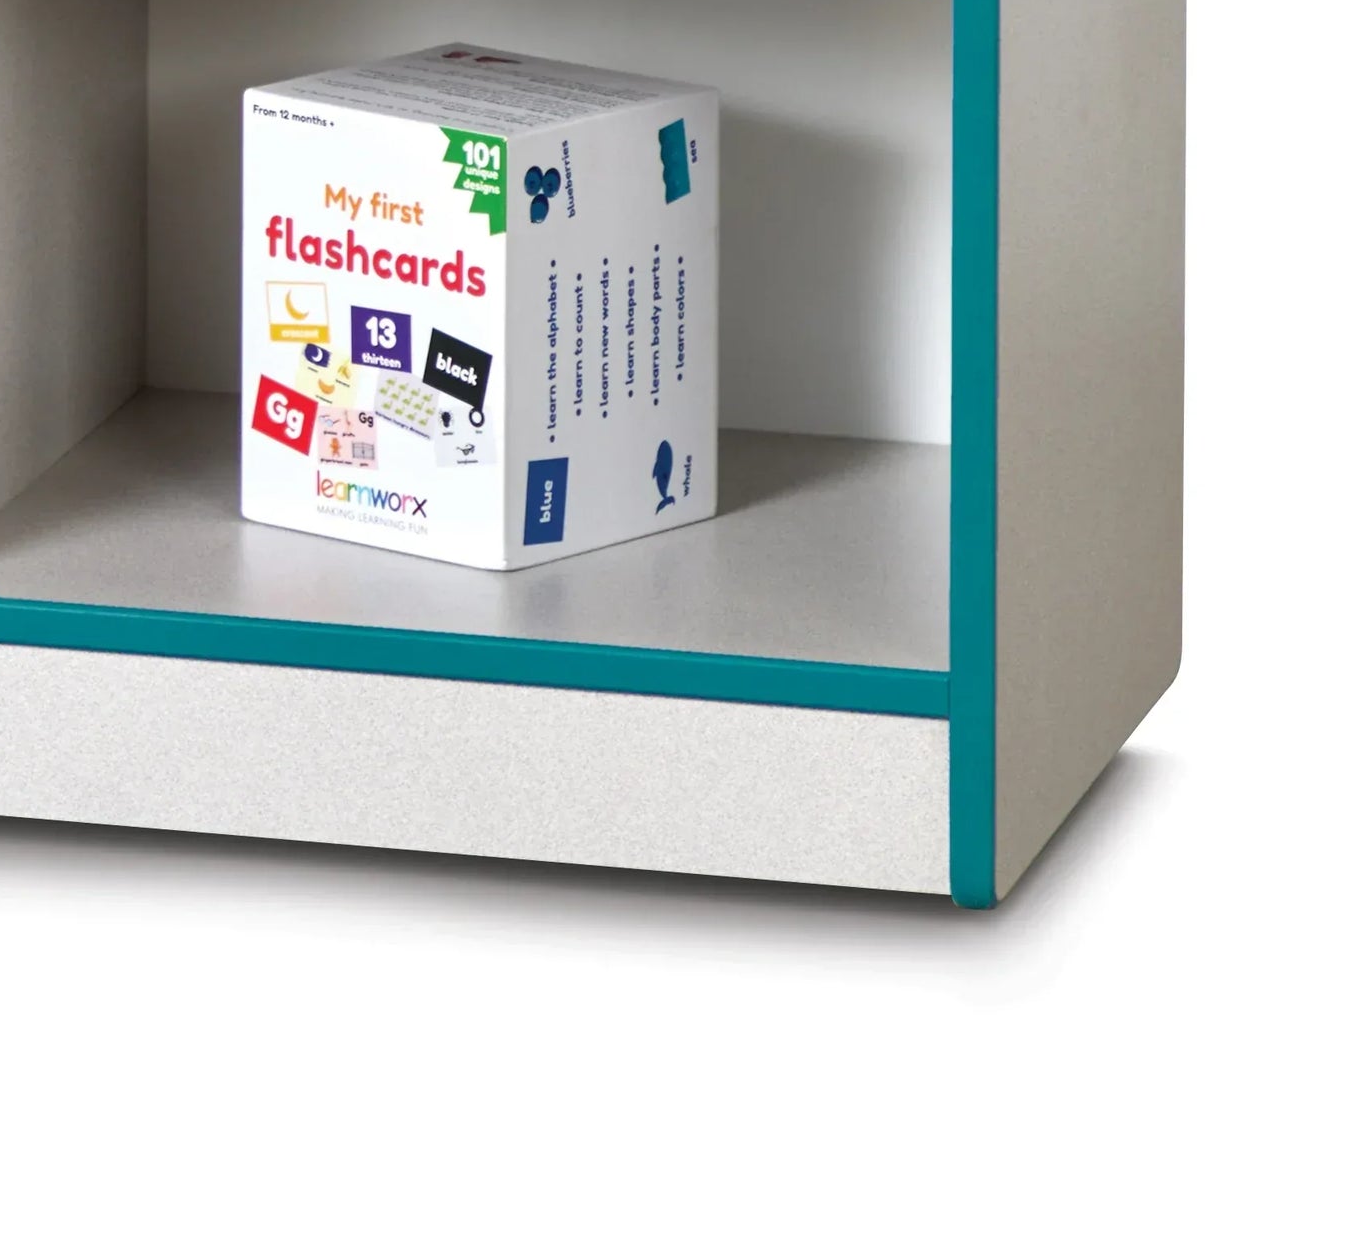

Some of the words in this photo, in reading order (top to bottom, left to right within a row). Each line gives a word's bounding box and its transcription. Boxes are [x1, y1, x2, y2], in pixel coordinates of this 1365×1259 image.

[252, 103, 277, 117] From
[279, 109, 290, 120] 12
[291, 113, 327, 127] months
[462, 140, 500, 170] 101
[464, 166, 498, 180] unique
[690, 140, 698, 164] sea
[462, 178, 501, 196] designs
[561, 140, 576, 218] blueberries
[325, 183, 363, 220] My
[370, 191, 424, 226] first
[265, 215, 487, 297] flashcards
[600, 270, 610, 321] words
[651, 256, 662, 301] parts
[675, 269, 686, 320] colors
[547, 273, 559, 348] alphabet
[574, 286, 583, 333] count
[625, 279, 637, 336] shapes
[650, 305, 662, 347] body
[365, 316, 397, 349] 13
[574, 337, 583, 356] to
[601, 325, 609, 358] new
[675, 324, 685, 369] learn
[361, 351, 401, 369] thirteen
[435, 351, 478, 387] black
[547, 352, 557, 381] the
[574, 360, 583, 404] learn
[625, 340, 635, 385] learn
[650, 349, 660, 395] learn
[599, 361, 609, 407] learn
[266, 391, 305, 440] Gg
[358, 412, 374, 428] Gg
[547, 384, 557, 429] learn
[316, 469, 428, 518] learnworx
[682, 454, 693, 498] whale
[316, 504, 355, 521] MAKING
[358, 512, 406, 531] LEARNING
[408, 522, 429, 536] FUN
[539, 479, 554, 524] blue
